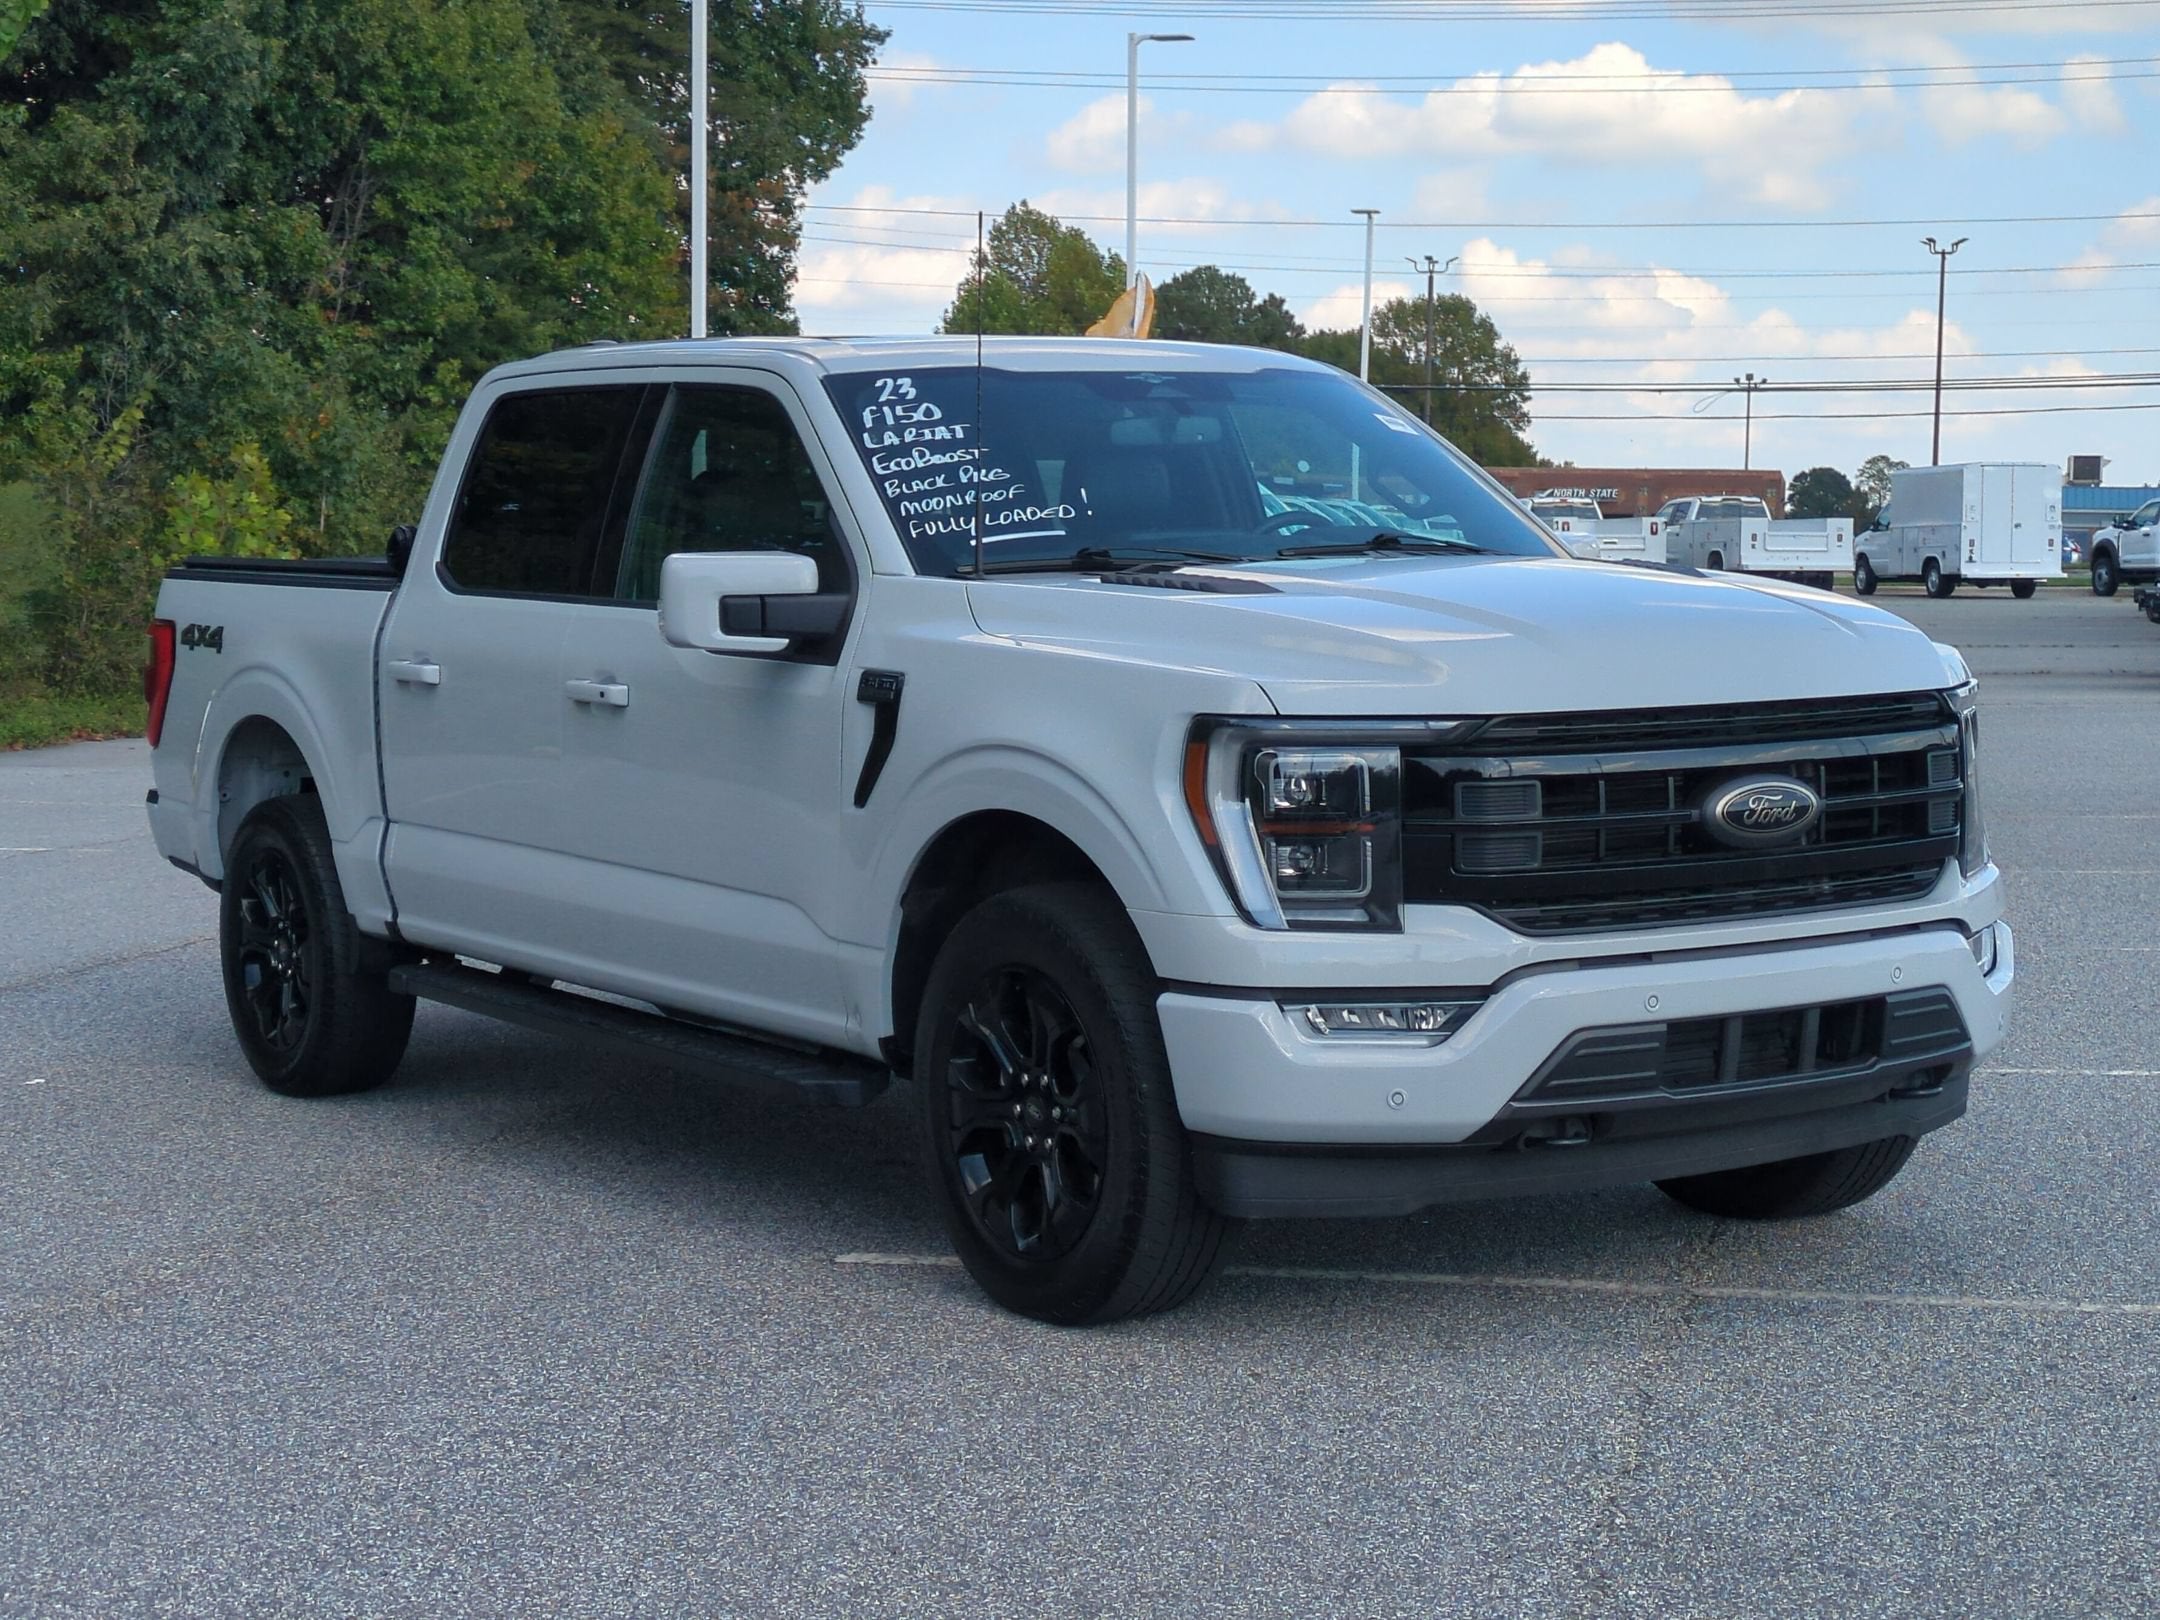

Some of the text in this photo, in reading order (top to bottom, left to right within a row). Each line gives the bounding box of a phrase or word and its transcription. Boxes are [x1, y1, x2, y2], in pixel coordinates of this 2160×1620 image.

[875, 377, 917, 402] 23
[862, 402, 942, 428] F150
[862, 423, 971, 448] LARIAT
[884, 474, 955, 498] BLACK
[1553, 488, 1618, 498] NORTH STATE
[909, 516, 977, 538] FULLY
[1743, 794, 1797, 825] Ford
